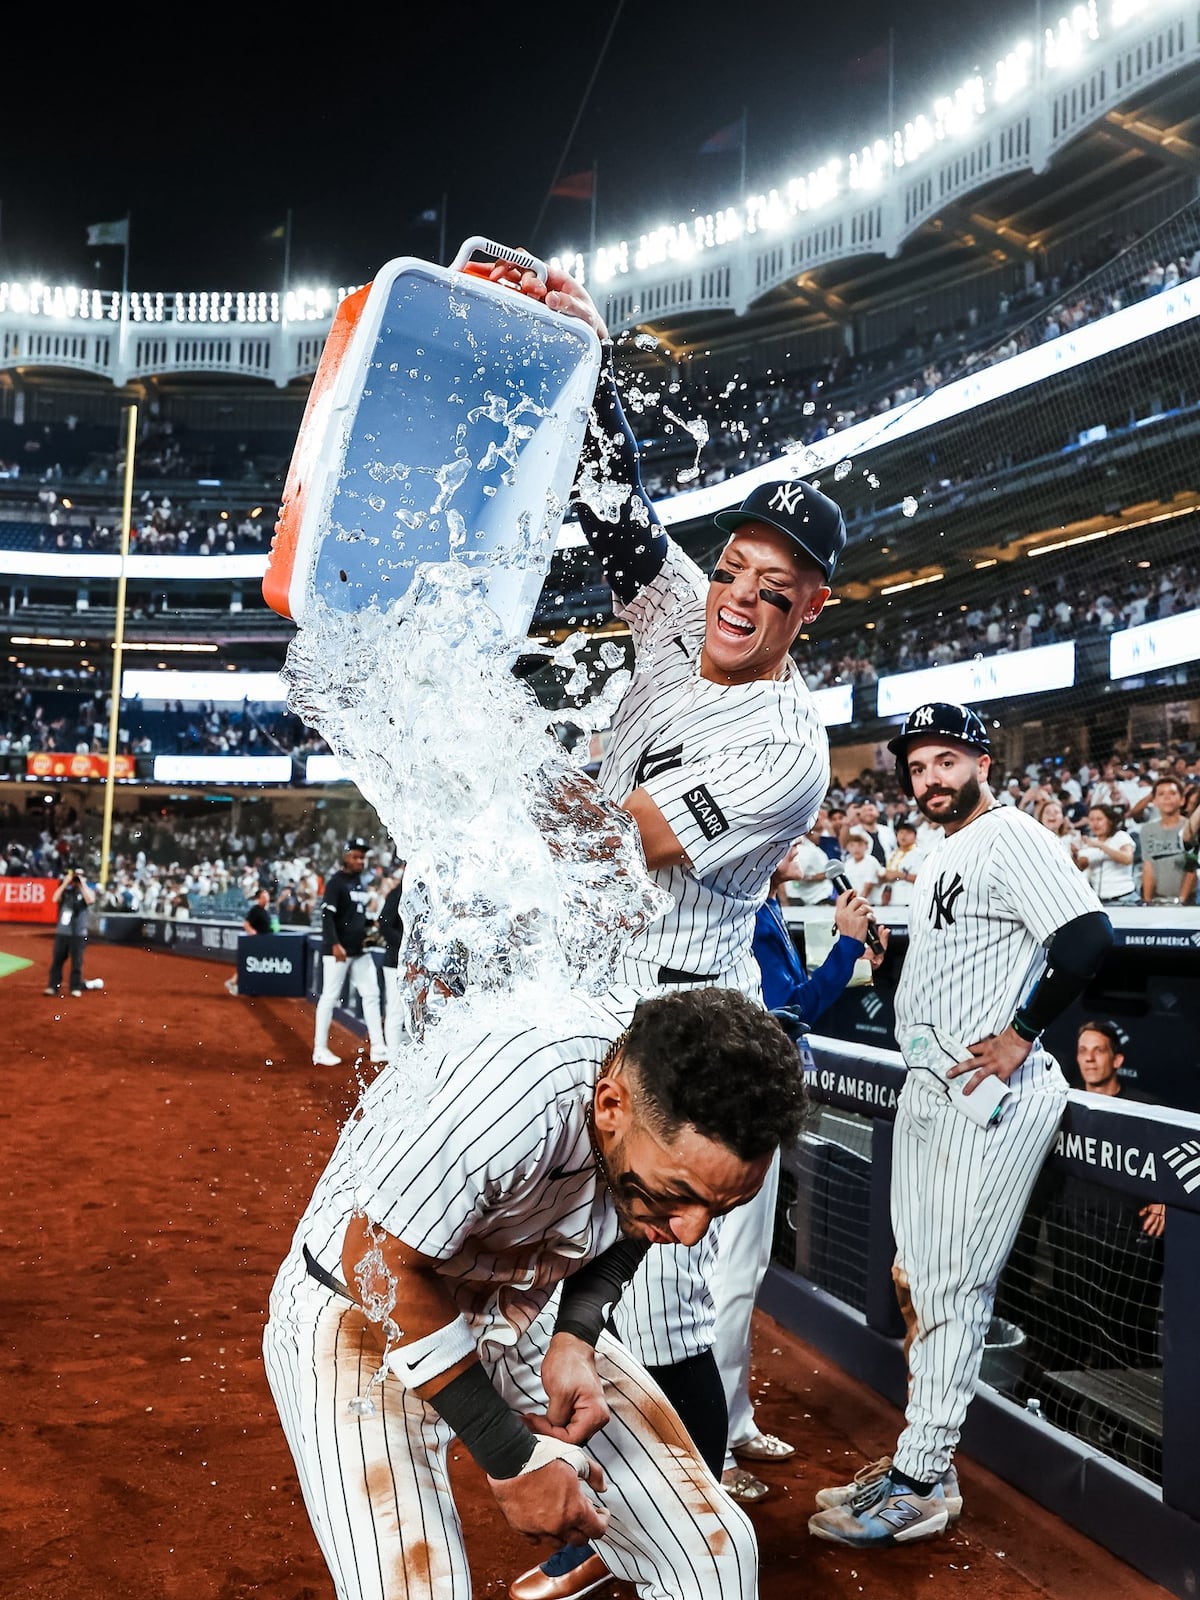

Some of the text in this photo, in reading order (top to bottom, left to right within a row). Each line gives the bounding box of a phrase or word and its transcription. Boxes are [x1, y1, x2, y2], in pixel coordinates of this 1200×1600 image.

[767, 482, 804, 515] NY
[914, 706, 934, 727] NY
[688, 790, 723, 836] STARR
[0, 883, 45, 903] EBB
[928, 870, 965, 930] NY
[1125, 935, 1145, 945] BANK
[1155, 936, 1190, 946] AMERICA
[246, 956, 292, 974] StubHub
[803, 1069, 897, 1109] NK OF AMERICA
[1054, 1130, 1157, 1182] AMERICA
